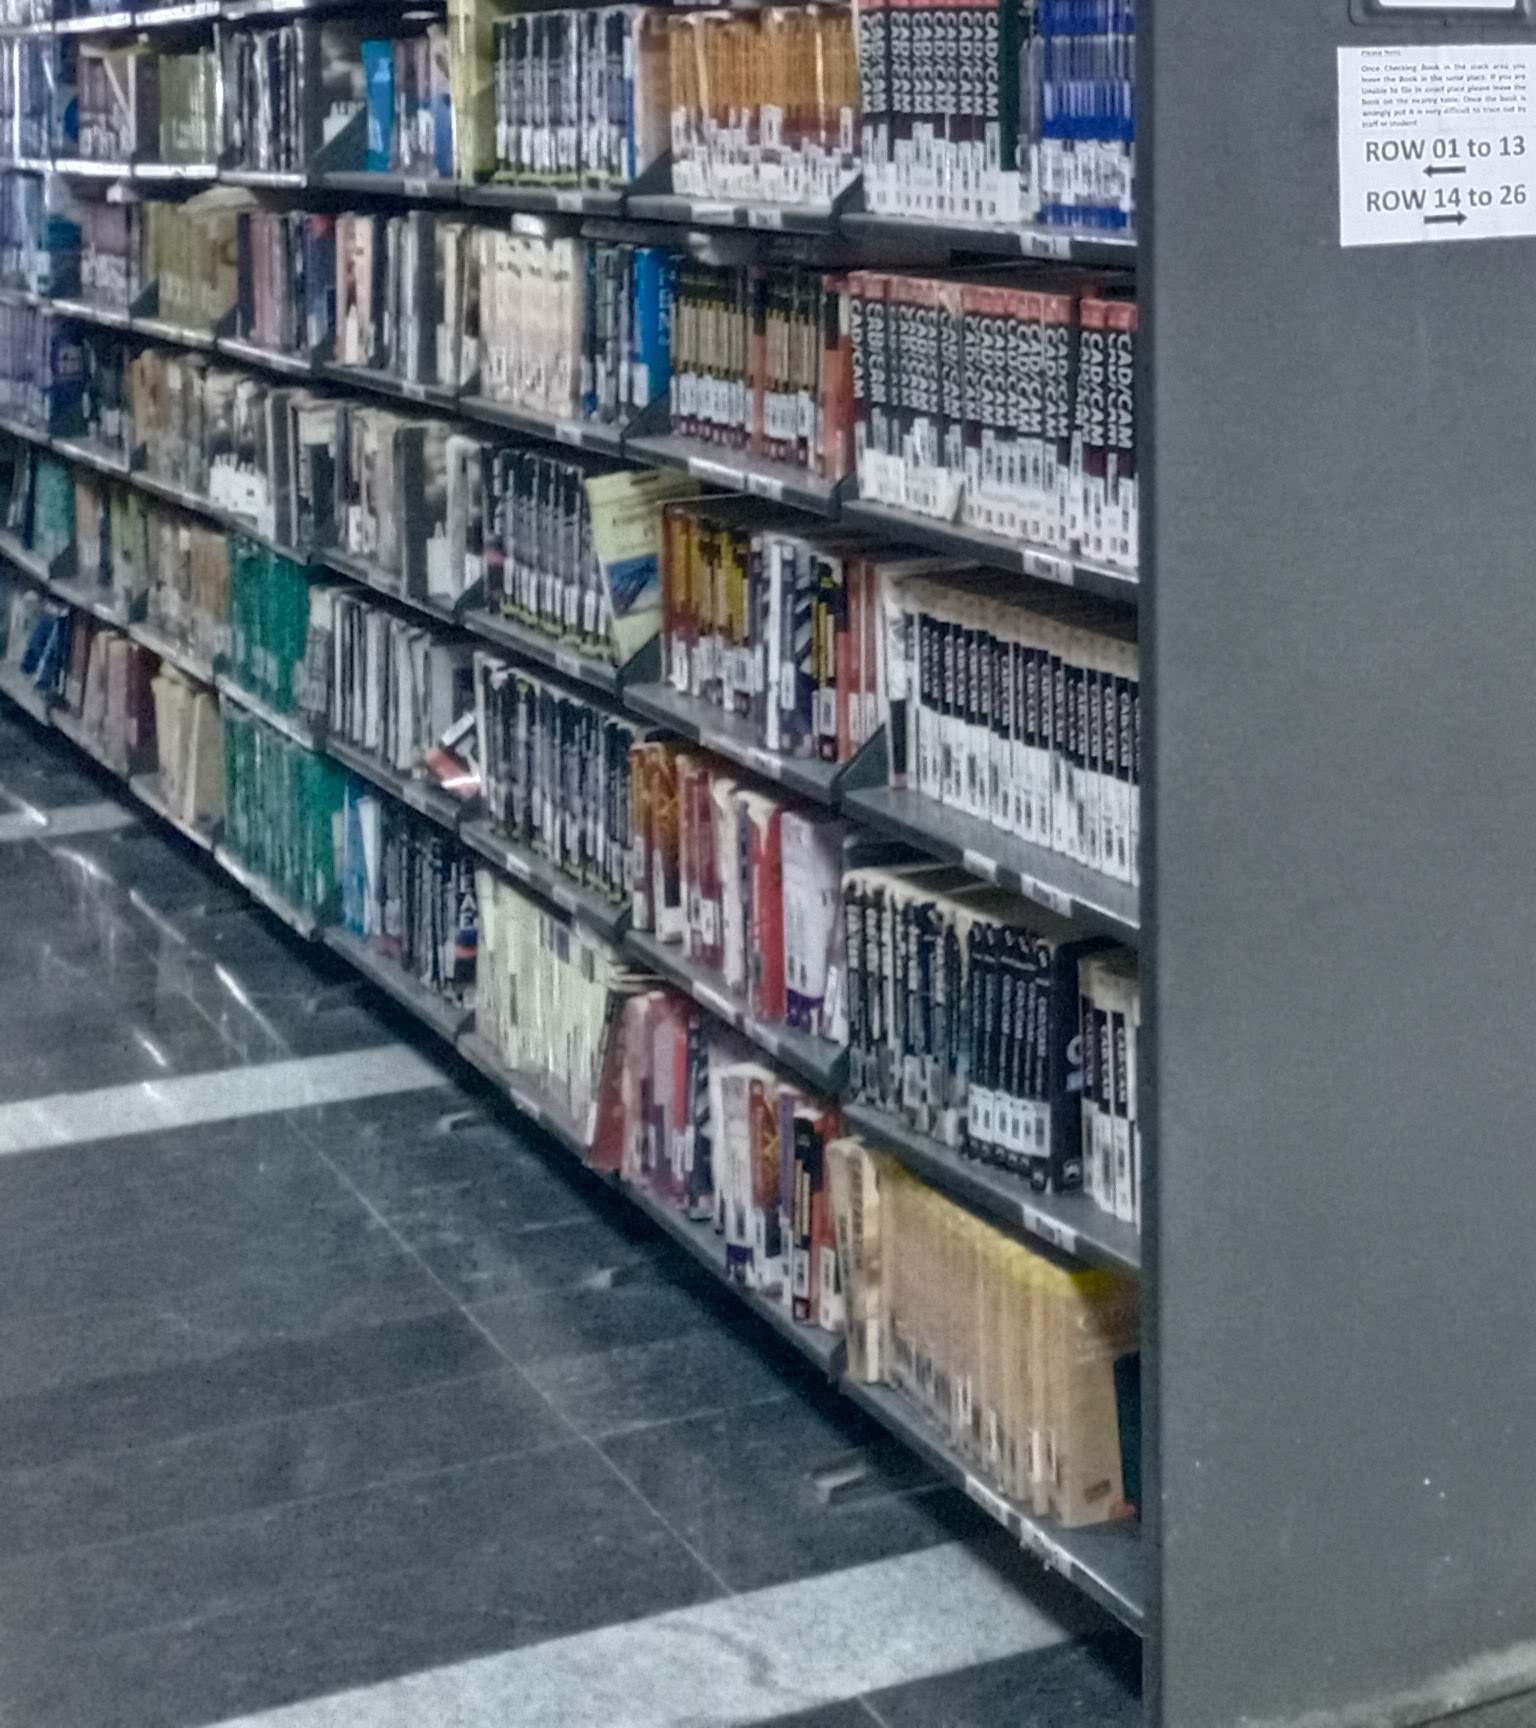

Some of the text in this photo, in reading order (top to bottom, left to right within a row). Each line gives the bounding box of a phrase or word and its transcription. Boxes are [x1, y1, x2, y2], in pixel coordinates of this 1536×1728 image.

[1364, 134, 1526, 164] ROW 01 to 13
[1365, 183, 1527, 214] ROW 14 to 26
